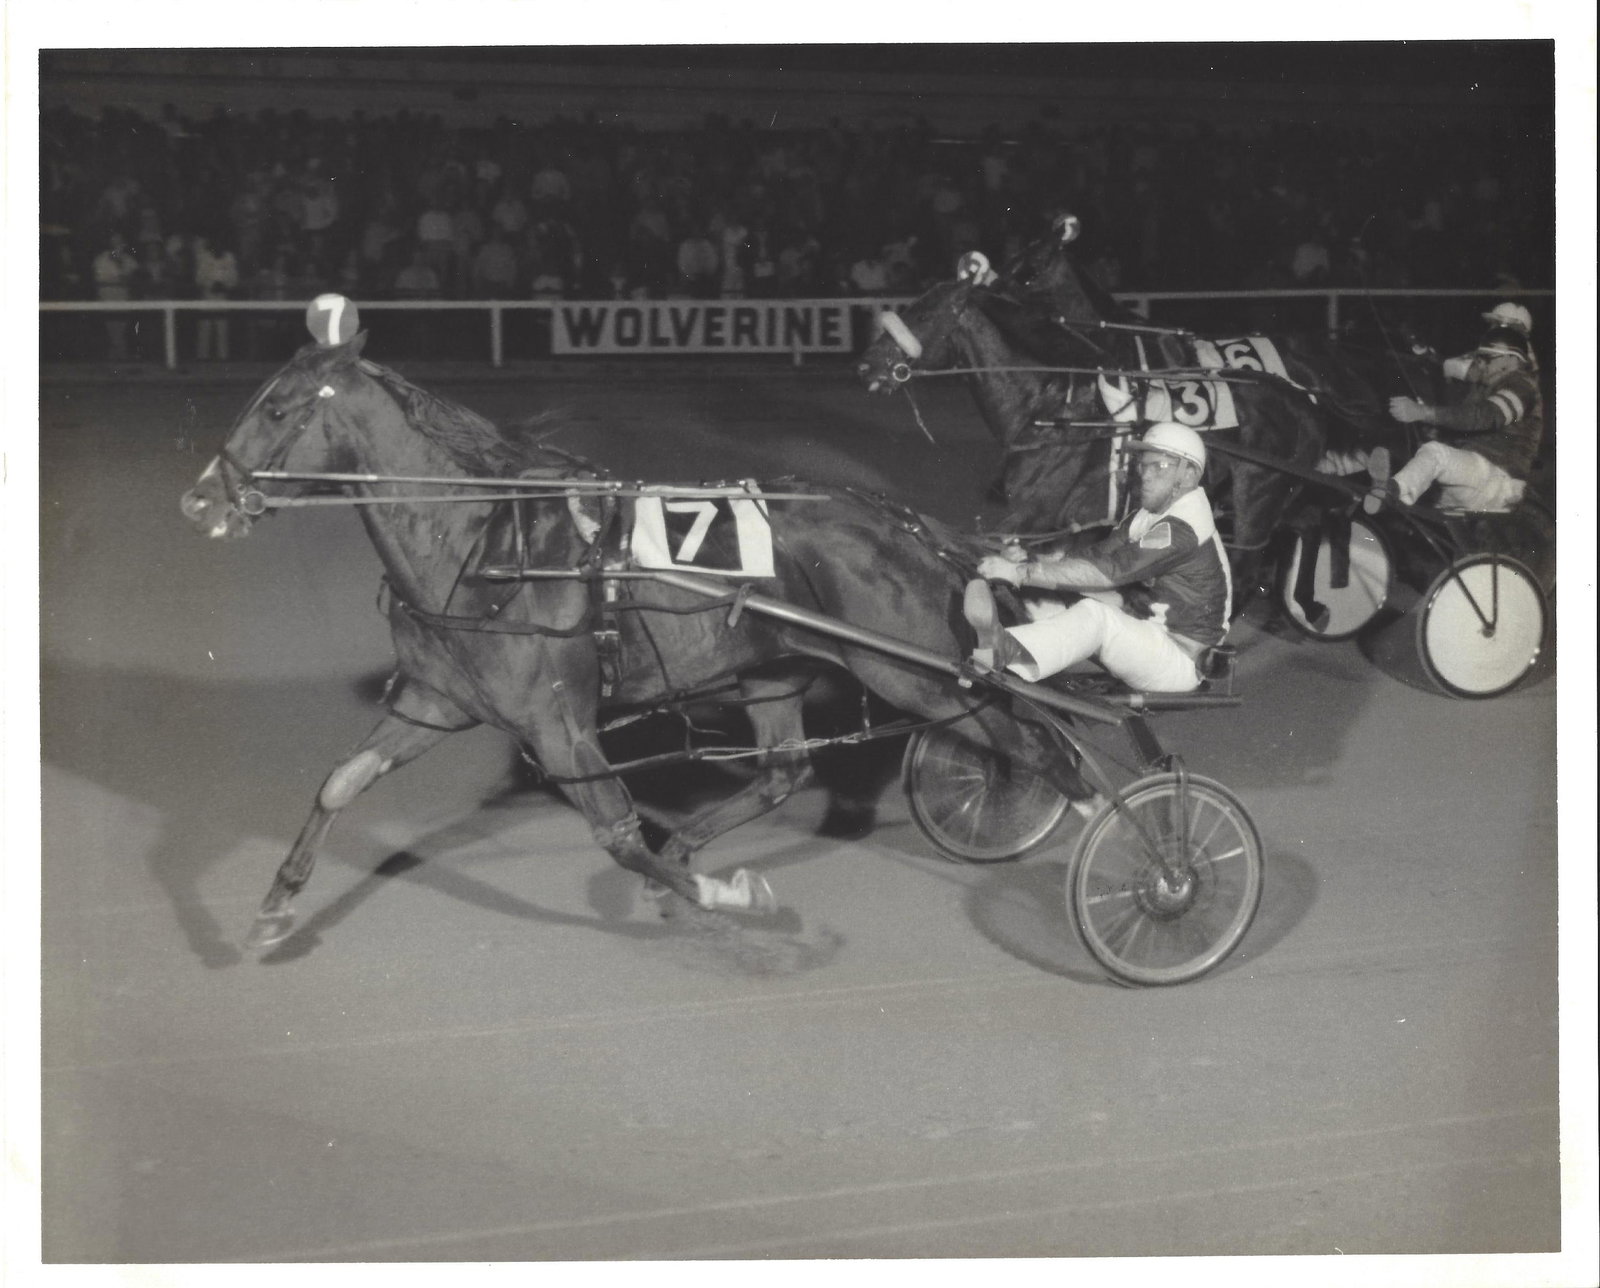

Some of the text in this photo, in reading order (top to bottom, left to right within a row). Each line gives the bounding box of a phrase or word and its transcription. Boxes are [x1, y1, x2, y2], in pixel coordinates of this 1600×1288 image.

[316, 296, 345, 345] 7
[561, 306, 843, 347] WOLVERINE
[1168, 380, 1209, 426] 3
[664, 501, 719, 562] 7
